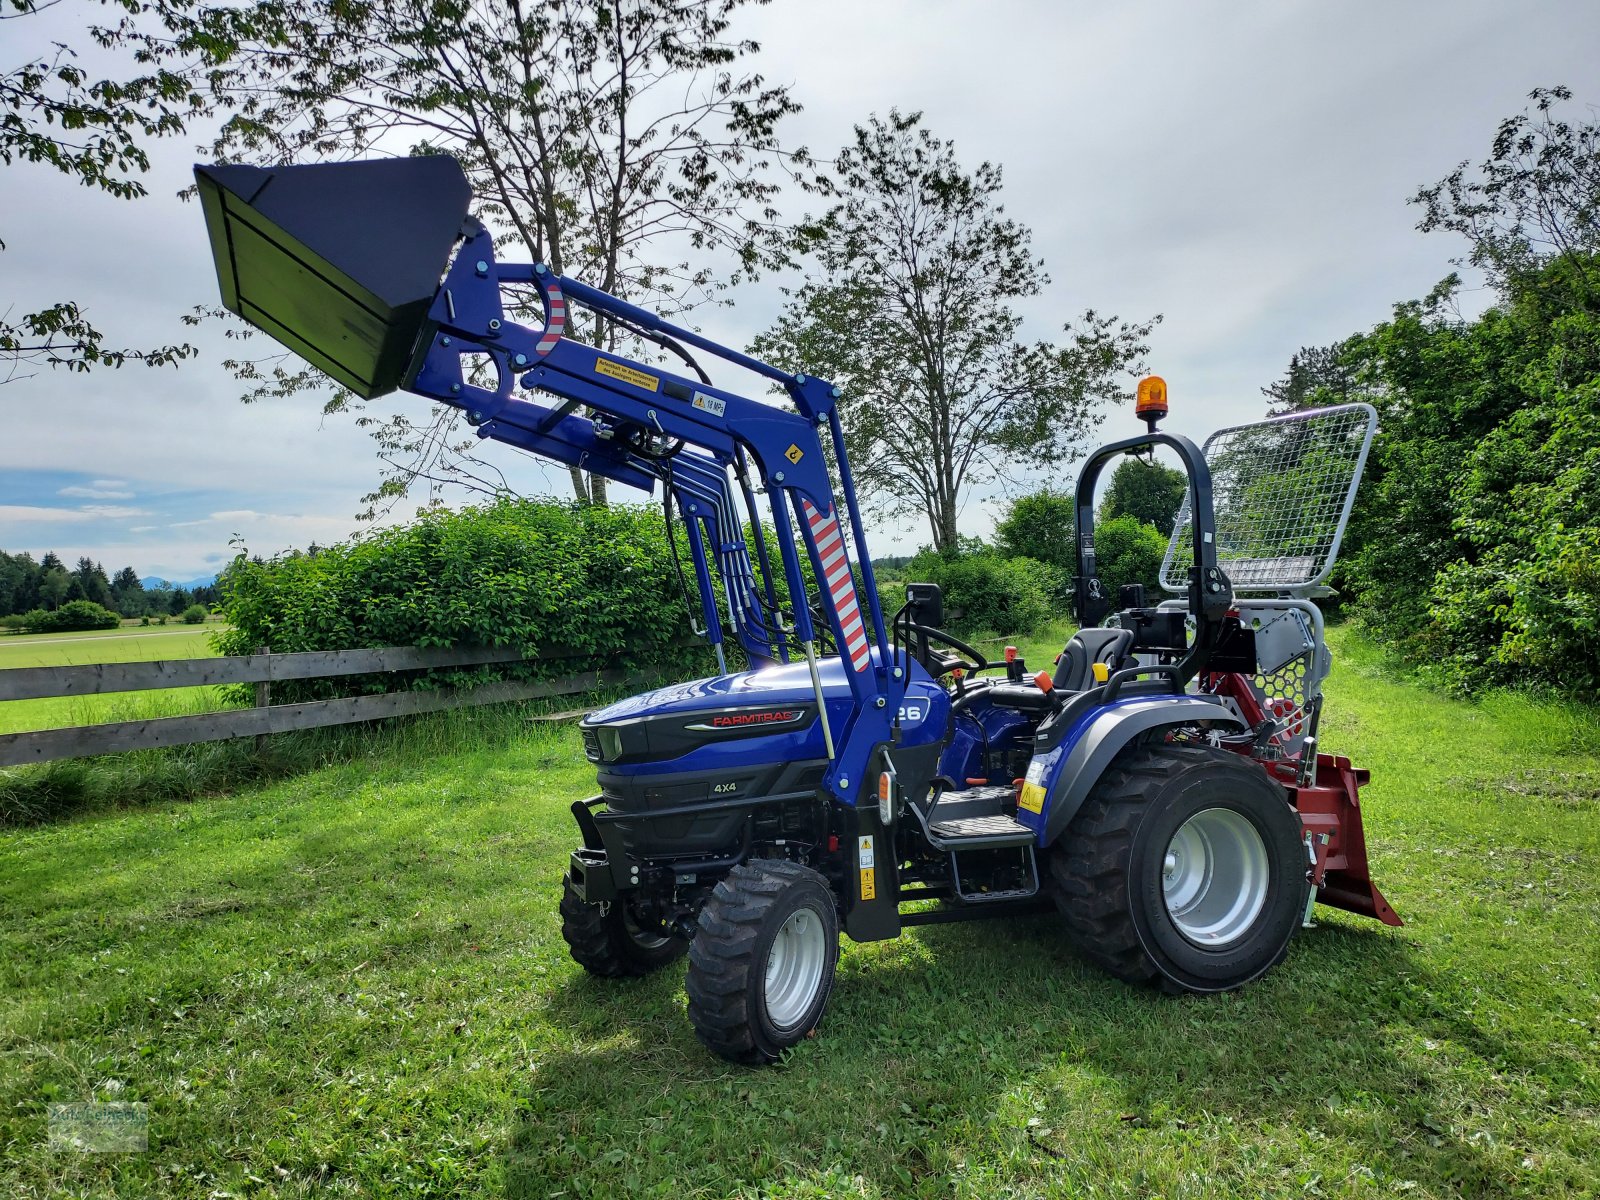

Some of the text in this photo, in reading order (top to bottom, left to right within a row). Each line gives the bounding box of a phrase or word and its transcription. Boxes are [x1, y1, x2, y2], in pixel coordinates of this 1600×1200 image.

[707, 399, 724, 413] 18 MPa
[713, 711, 793, 727] FARMTRAC
